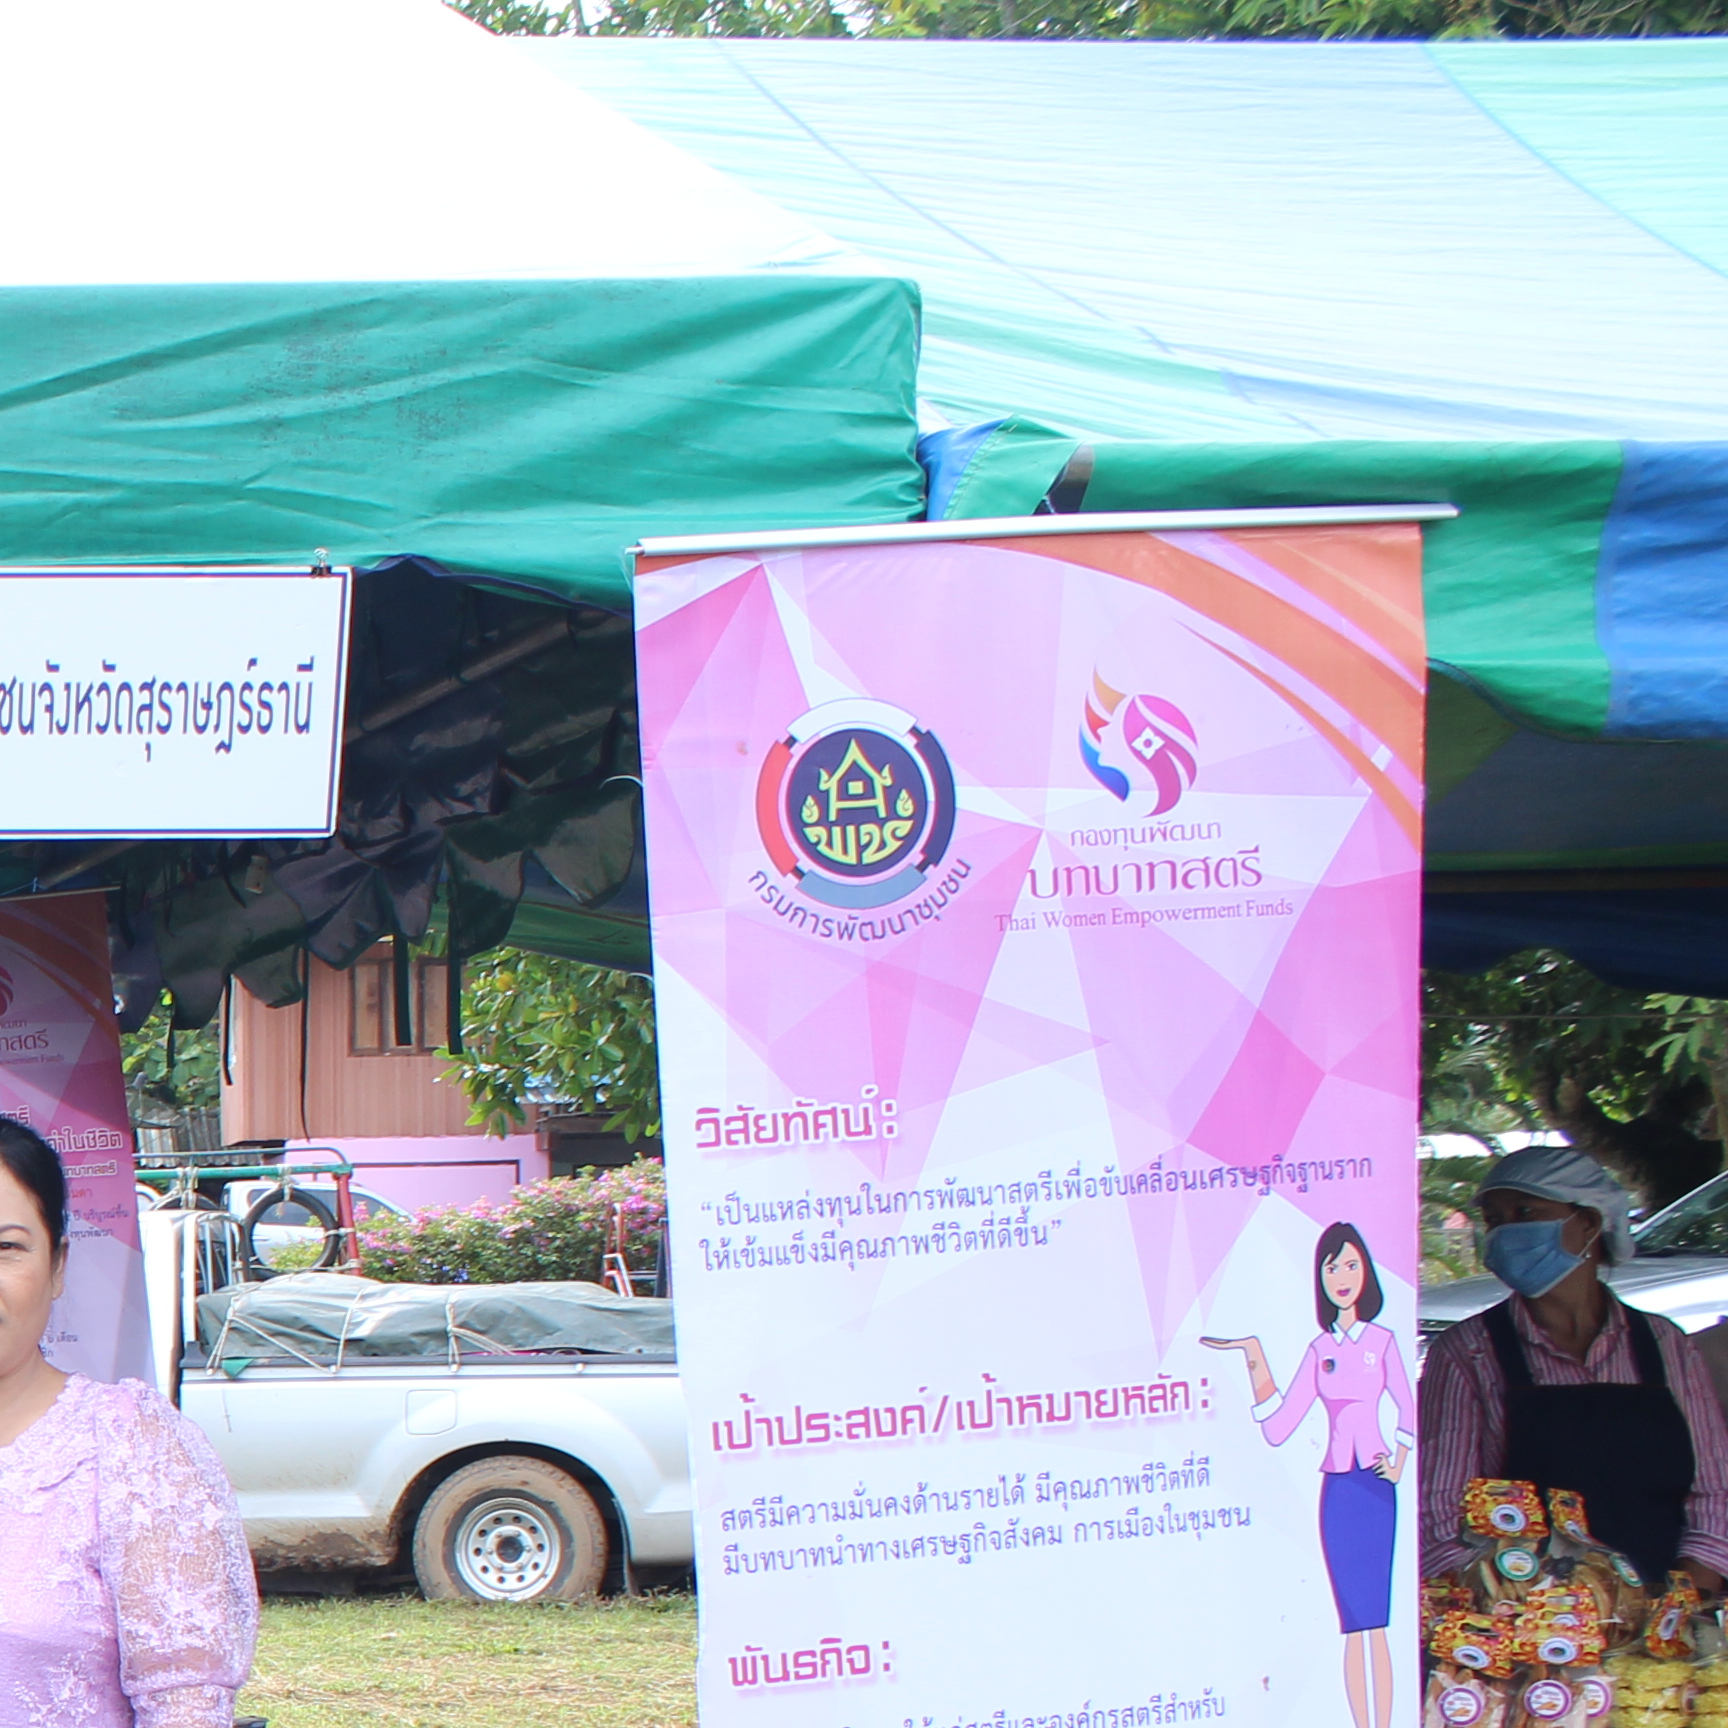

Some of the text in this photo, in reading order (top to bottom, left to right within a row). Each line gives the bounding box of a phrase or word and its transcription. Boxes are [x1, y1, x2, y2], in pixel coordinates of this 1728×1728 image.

[1071, 820, 1221, 848] กองทุนพัฒนา
[748, 857, 972, 942] กรมการพัฒนาชุมชน
[1026, 847, 1263, 899] บทบาทสตรี
[995, 899, 1294, 932] Thai Women Empowerment Funds
[720, 1450, 1211, 1531] สตรีมีความมั่นคงด้านรายได้ มีคุณภาพชีวิตที่ดี
[722, 1502, 1251, 1575] มีบทบาทนำทางเศรษฐกิจสังคม การเมืองในชุมชน
